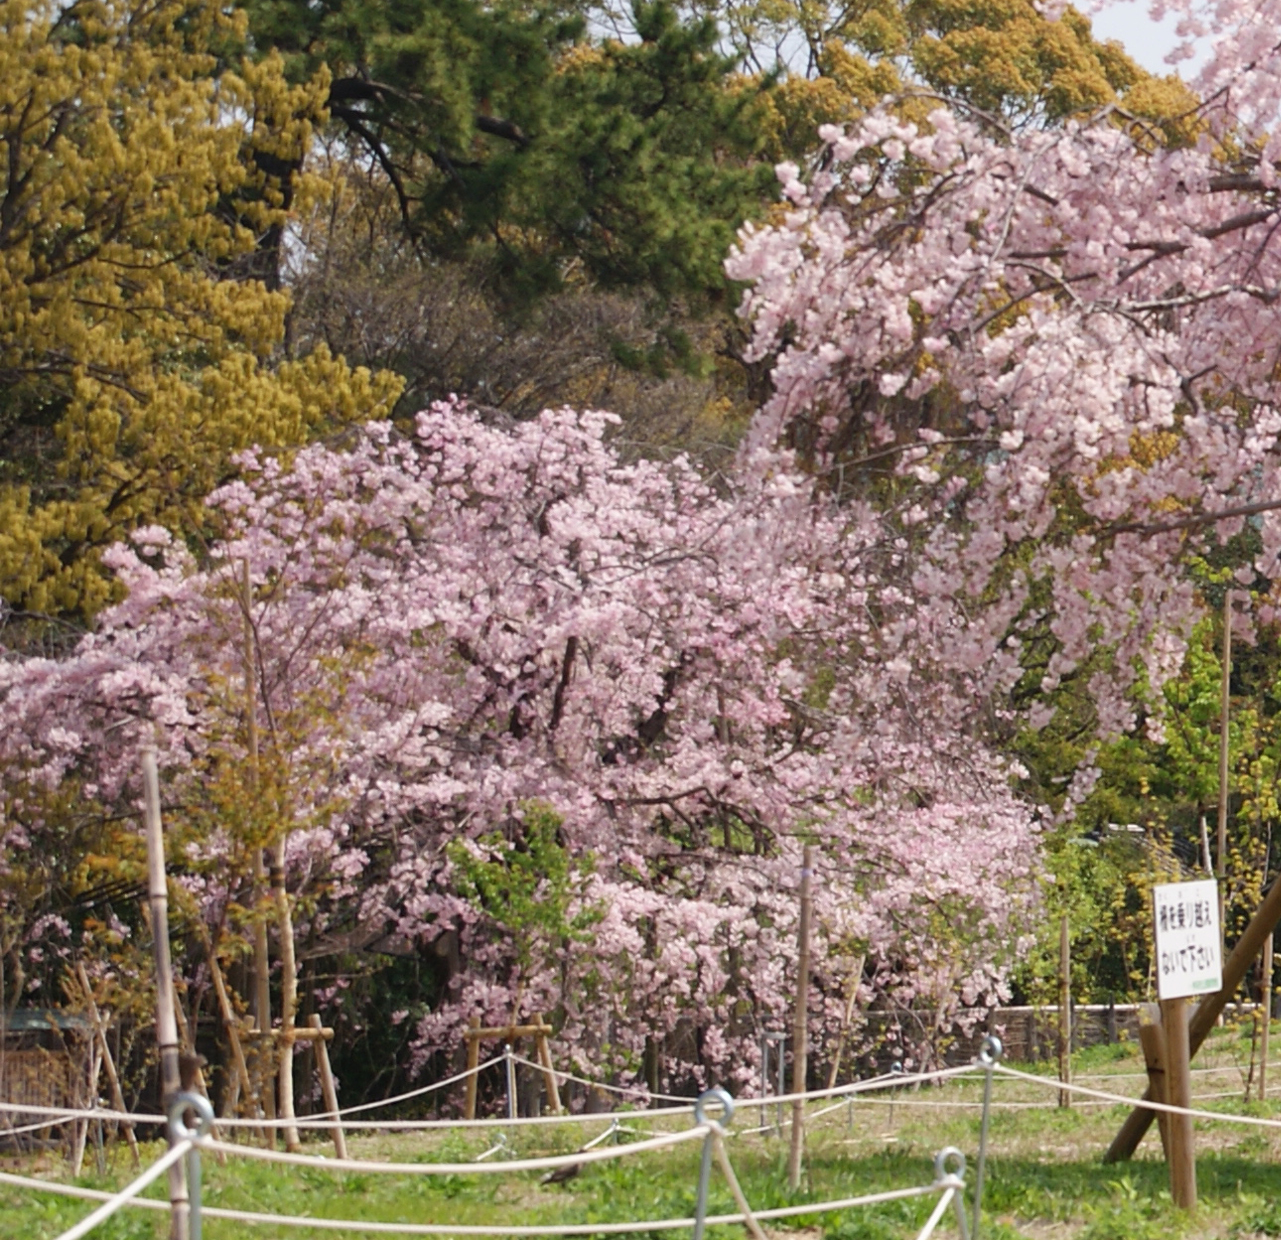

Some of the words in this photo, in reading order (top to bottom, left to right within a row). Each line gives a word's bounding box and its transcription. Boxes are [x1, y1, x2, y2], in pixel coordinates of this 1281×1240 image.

[1161, 945, 1213, 975] ないで下さい
